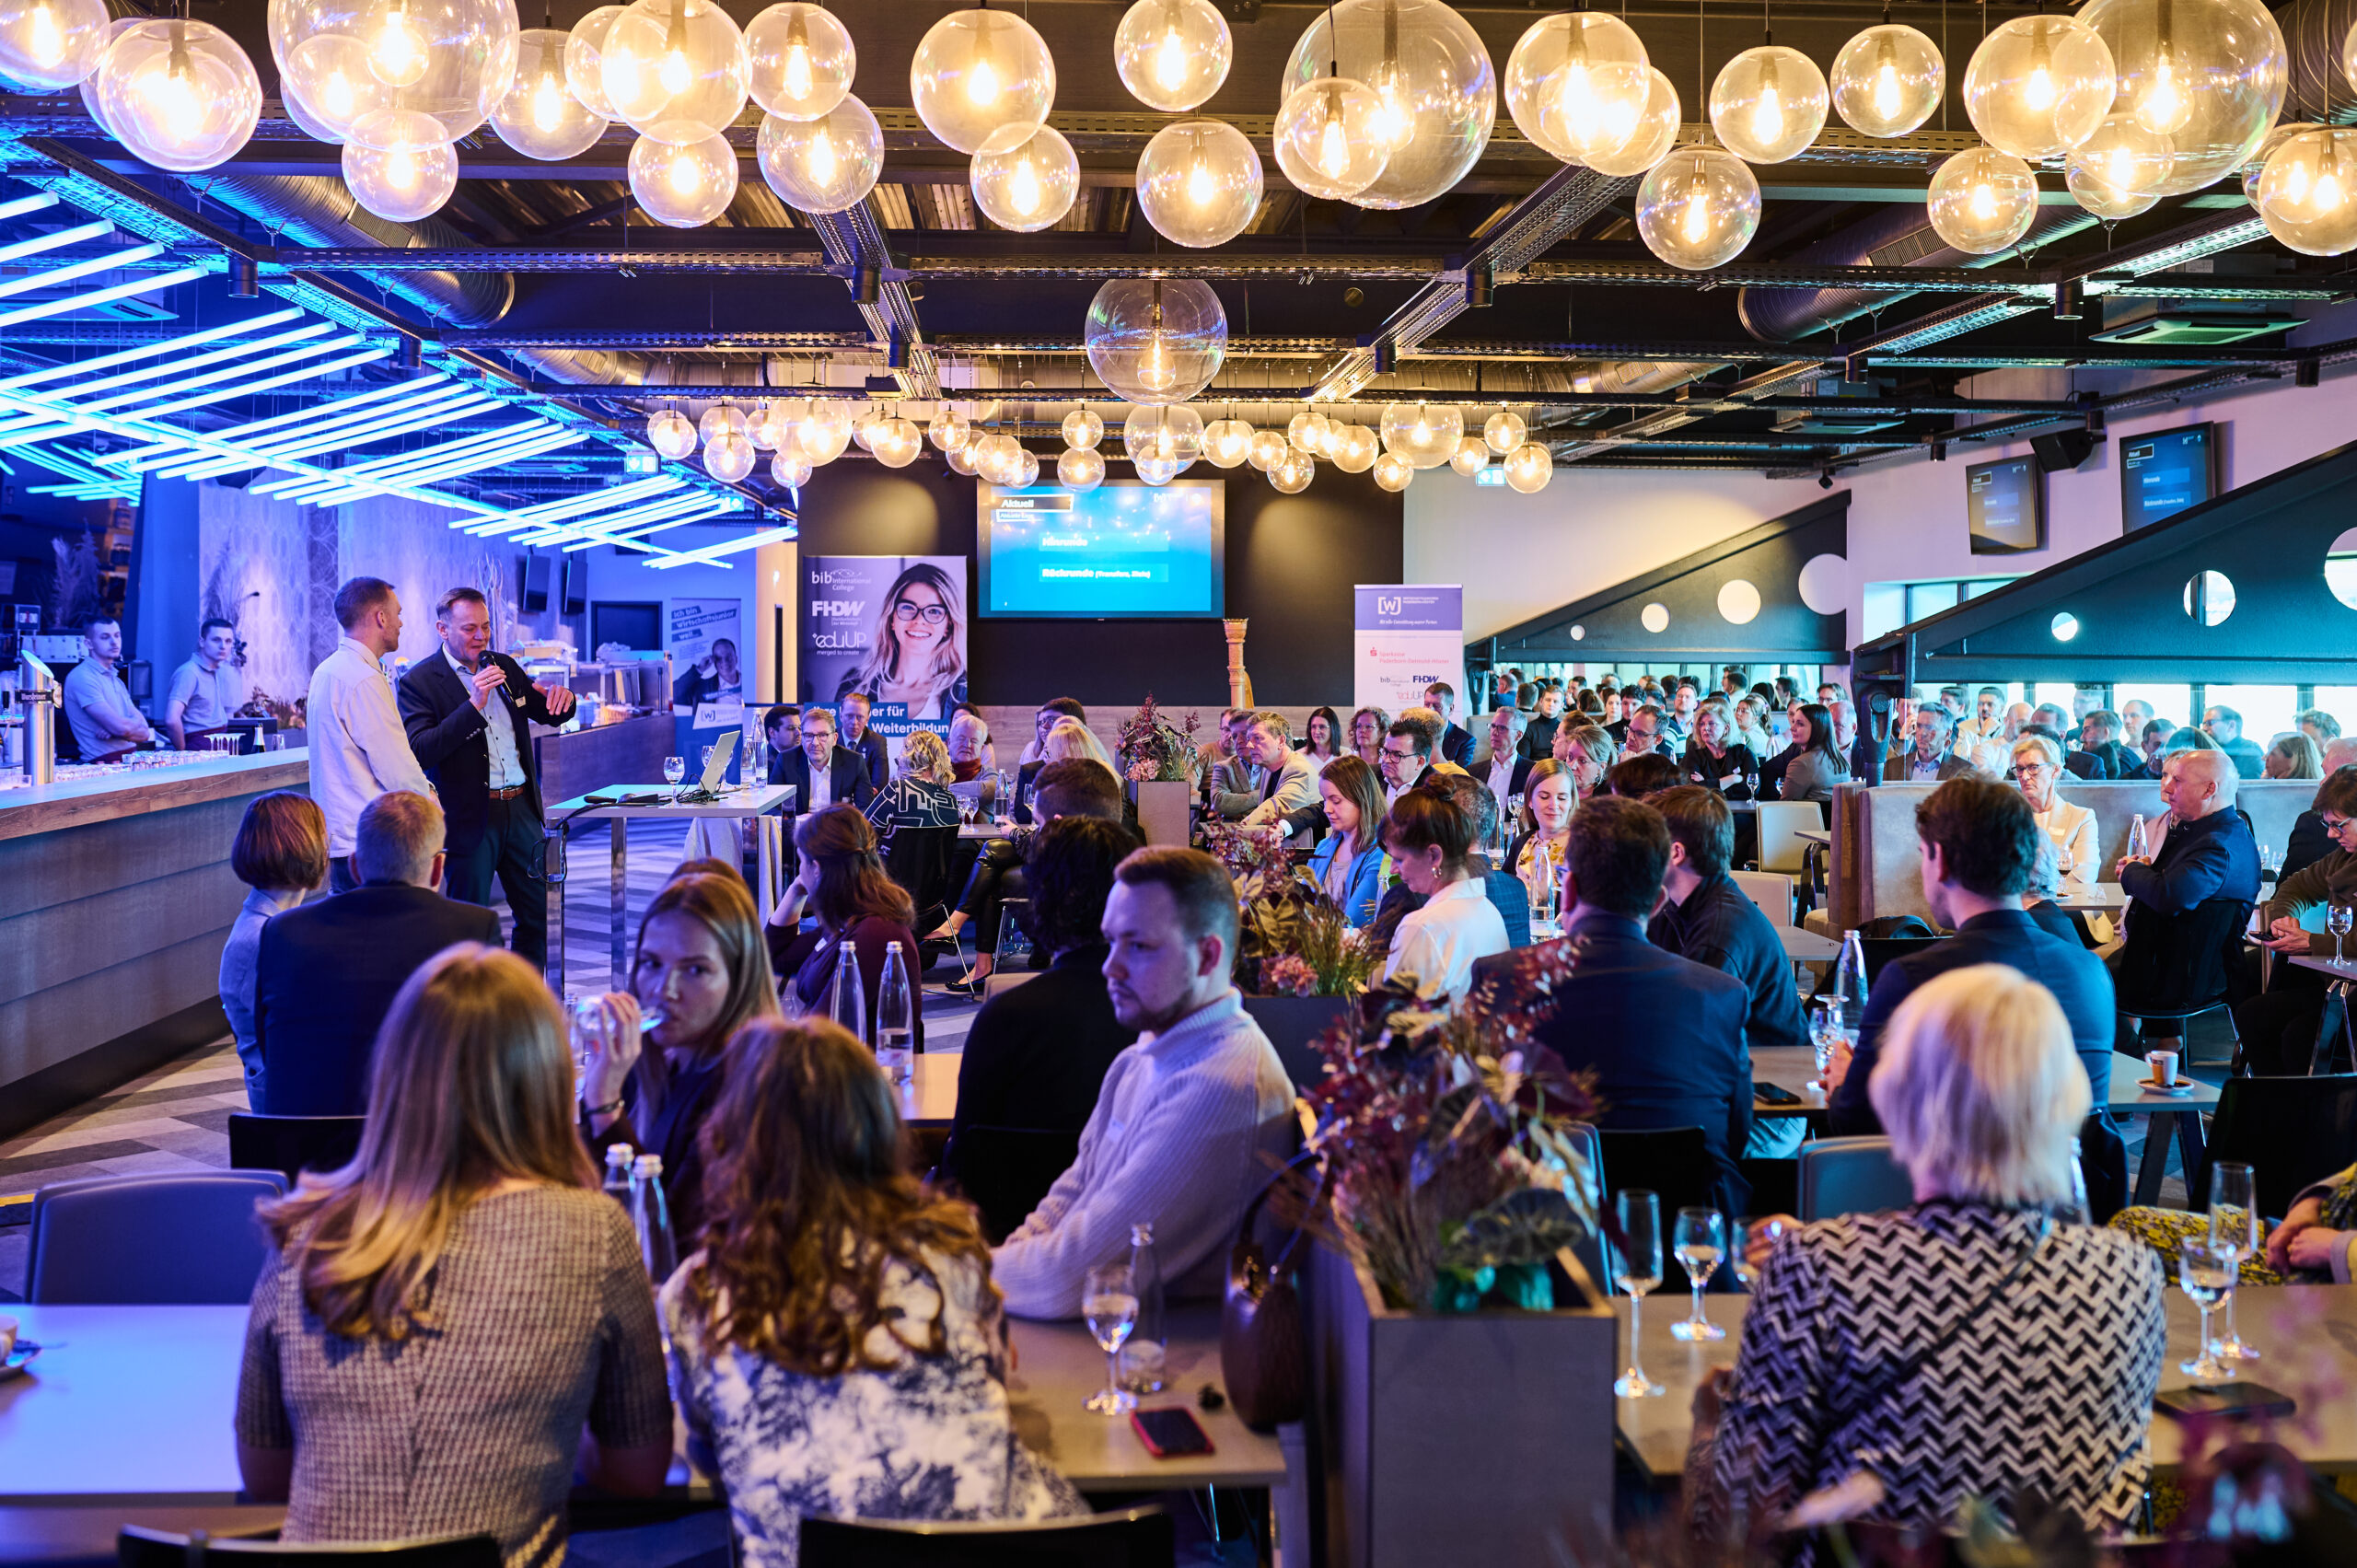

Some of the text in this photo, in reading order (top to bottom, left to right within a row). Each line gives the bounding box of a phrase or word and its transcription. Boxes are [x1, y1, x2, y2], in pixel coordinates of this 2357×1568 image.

[1001, 499, 1034, 508] Aktuell
[1042, 537, 1088, 546] Hinrunde
[812, 571, 832, 584] bib
[1042, 568, 1094, 577] Rückrunde
[812, 600, 865, 617] FHDW
[1412, 675, 1439, 683] FHDW
[887, 703, 904, 717] für
[871, 722, 948, 734] Weiterbildun
